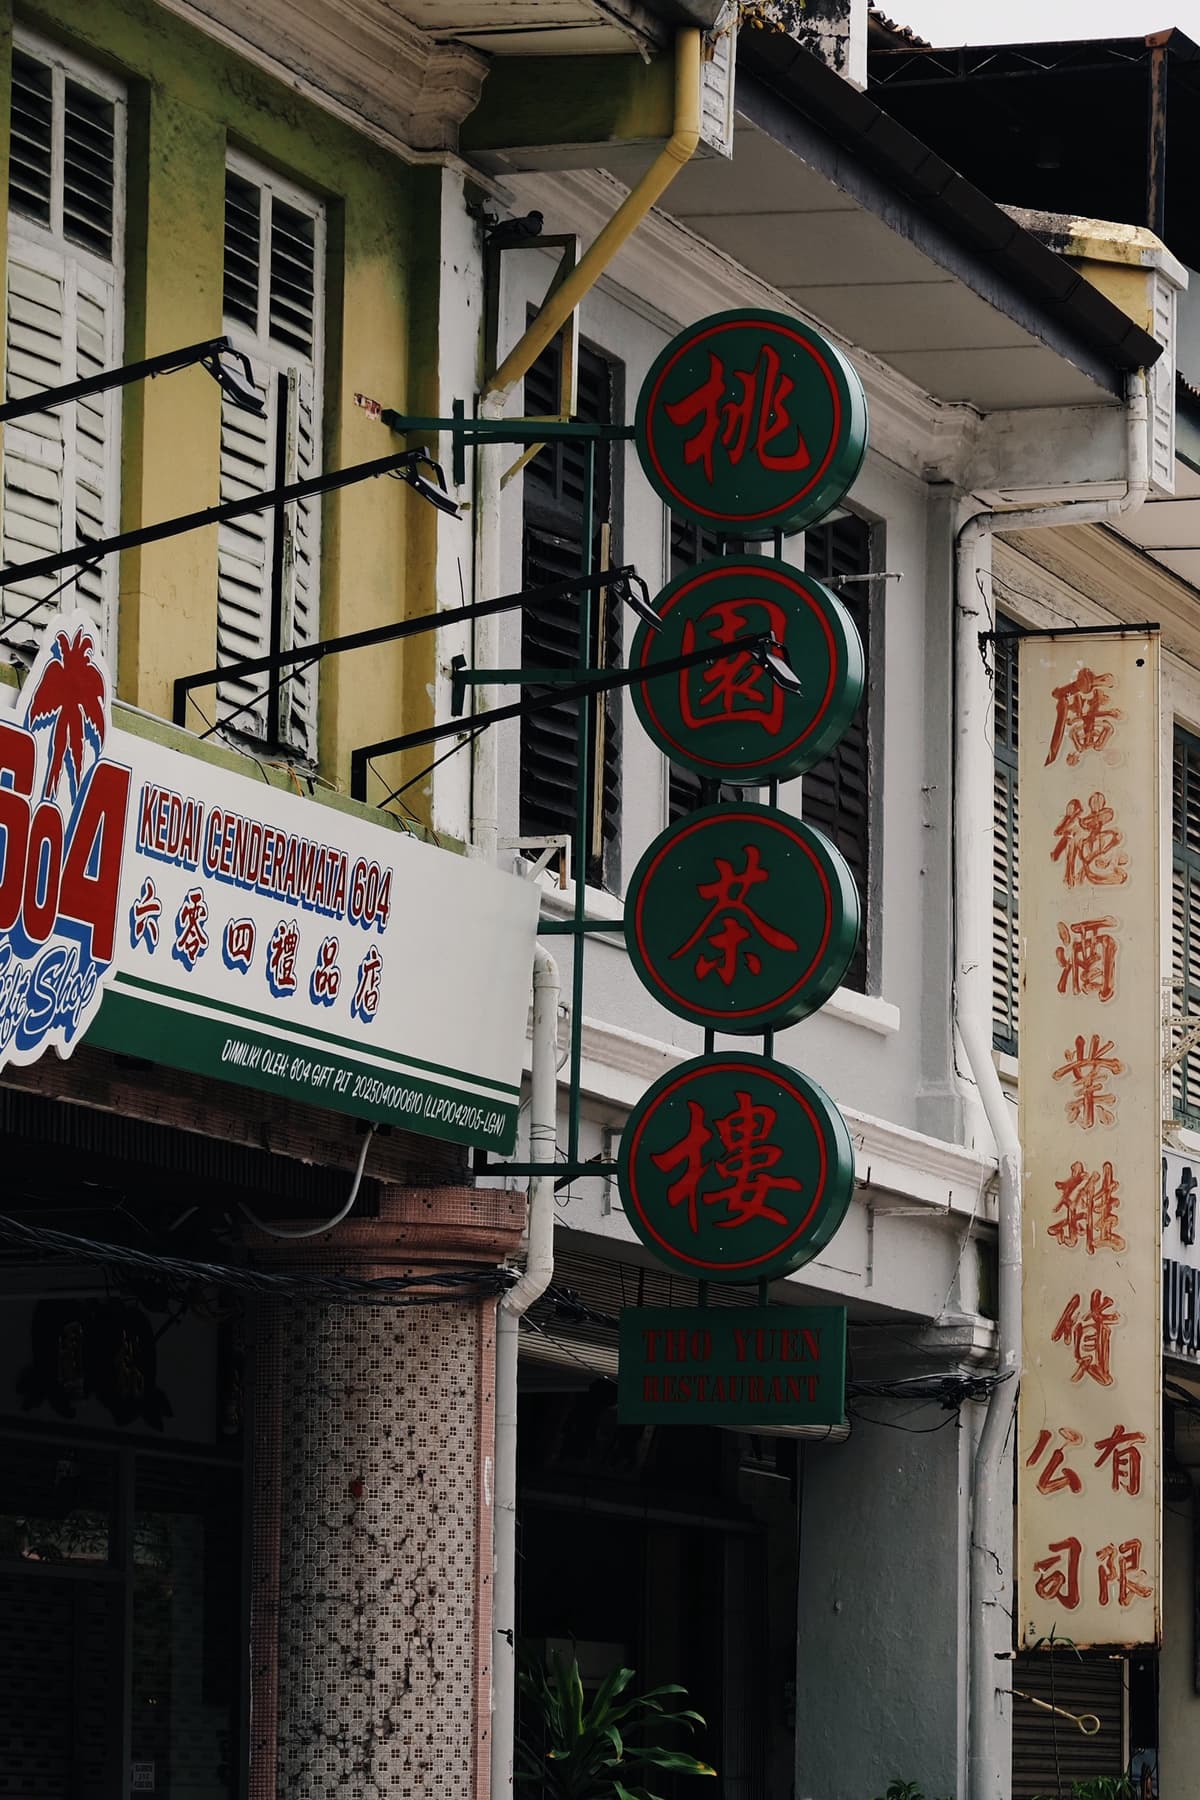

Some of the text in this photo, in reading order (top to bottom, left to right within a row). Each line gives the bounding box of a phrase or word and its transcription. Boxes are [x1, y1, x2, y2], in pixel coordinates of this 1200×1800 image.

[138, 782, 393, 930] KEDAI CENDERAMATA 604
[24, 946, 97, 1035] Shop
[132, 877, 383, 1019] 六零四禮品店
[221, 1039, 262, 1068] DIMILIKI
[261, 1049, 290, 1078] OLEH:
[290, 1059, 310, 1082] 604
[311, 1063, 334, 1089] GIFT
[334, 1068, 353, 1094] PLT
[641, 1326, 822, 1363] THO YUEN
[641, 1375, 820, 1403] RESTAURANT
[1026, 1428, 1083, 1610] 公司
[1095, 1424, 1152, 1606] 有限
